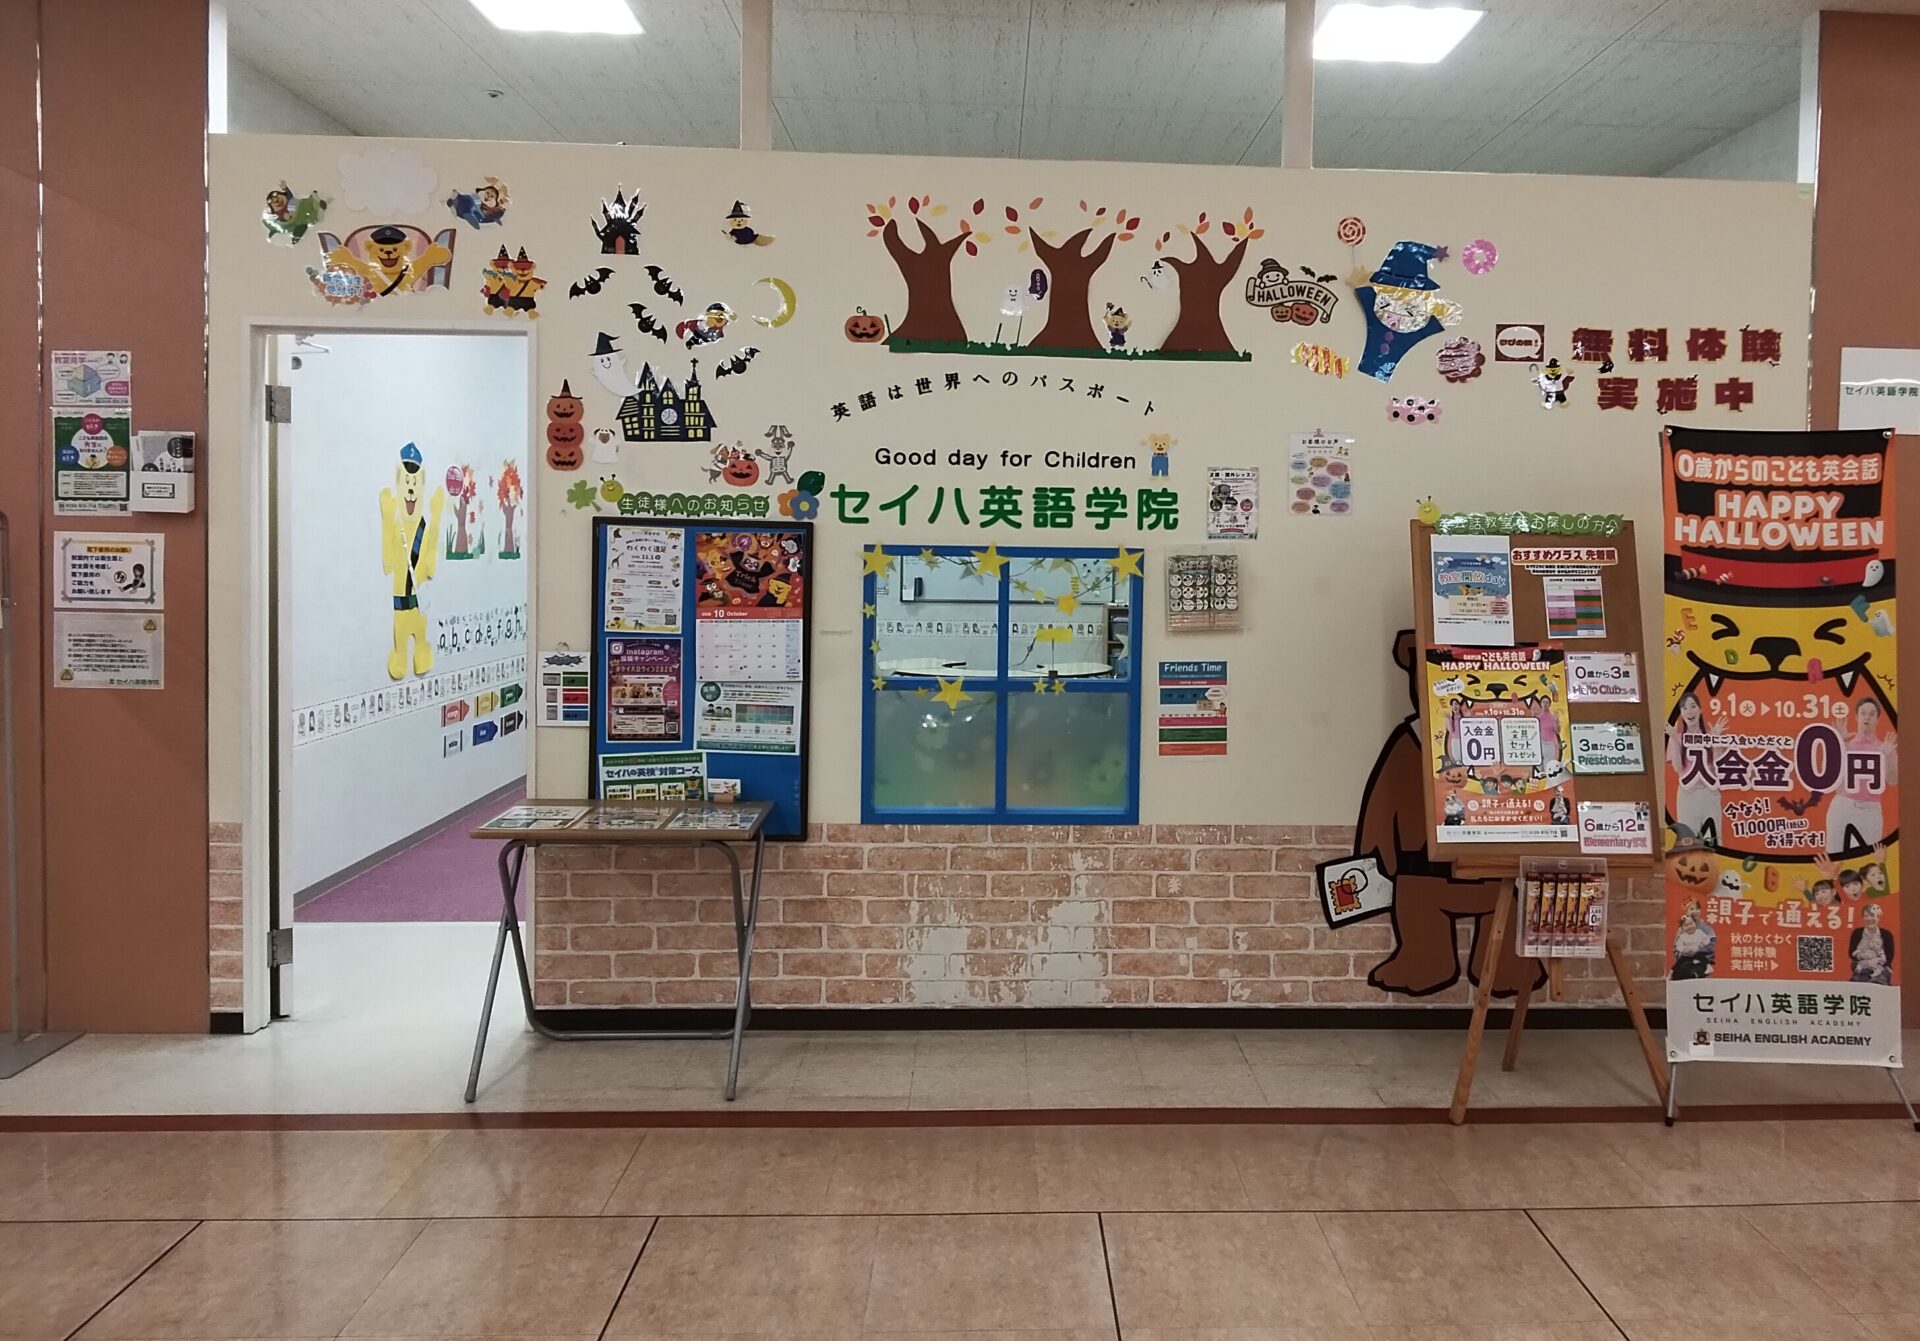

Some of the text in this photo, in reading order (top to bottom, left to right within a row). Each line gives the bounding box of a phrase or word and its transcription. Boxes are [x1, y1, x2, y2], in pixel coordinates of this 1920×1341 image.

[1257, 284, 1332, 306] HALLOWEEN
[1572, 328, 1783, 362] 無料体験
[831, 371, 1154, 422] 英語は世界へのパスポート
[1597, 377, 1754, 411] 実施中
[1845, 386, 1918, 396] セイハ英語学院
[875, 448, 1136, 470] Good day for Children
[1678, 454, 1879, 482] 0歳からのこども英会話
[621, 496, 766, 512] 生徒様へのお知らせ
[830, 483, 1180, 531] セイハ英語学院
[1718, 494, 1840, 519] HAPPY
[1675, 517, 1884, 546] HALLOWEEN
[1512, 549, 1616, 561] おすすめクラス 先着順
[1438, 571, 1506, 587] 教室開放day
[714, 610, 724, 618] 10
[626, 648, 664, 656] Instagram
[1164, 663, 1222, 672] Friends Time
[1441, 662, 1549, 671] HAPPY HALLOWEEN
[1575, 666, 1630, 679] 0歳から3歳
[1464, 726, 1494, 736] 入会金
[1509, 740, 1532, 749] セット
[1579, 738, 1634, 752] 3歳から6歳
[1684, 734, 1792, 746] 期間中にご入会いただくと
[1467, 738, 1495, 760] 0円
[1482, 799, 1531, 809] 親子で通える!
[1724, 799, 1770, 819] 今なら!
[1584, 818, 1646, 832] 6歳から12歳
[1733, 819, 1808, 836] 11,000円(税込)
[1766, 832, 1825, 847] お得です!
[1706, 898, 1855, 929] 親子で通える!
[1731, 933, 1792, 944] 秋のわくわく
[1731, 946, 1776, 958] 無料体験
[1731, 959, 1768, 971] 実施中!
[1693, 993, 1872, 1016] セイハ英語学院
[1714, 1033, 1872, 1046] SEIHA ENGLISH ACADEMY
